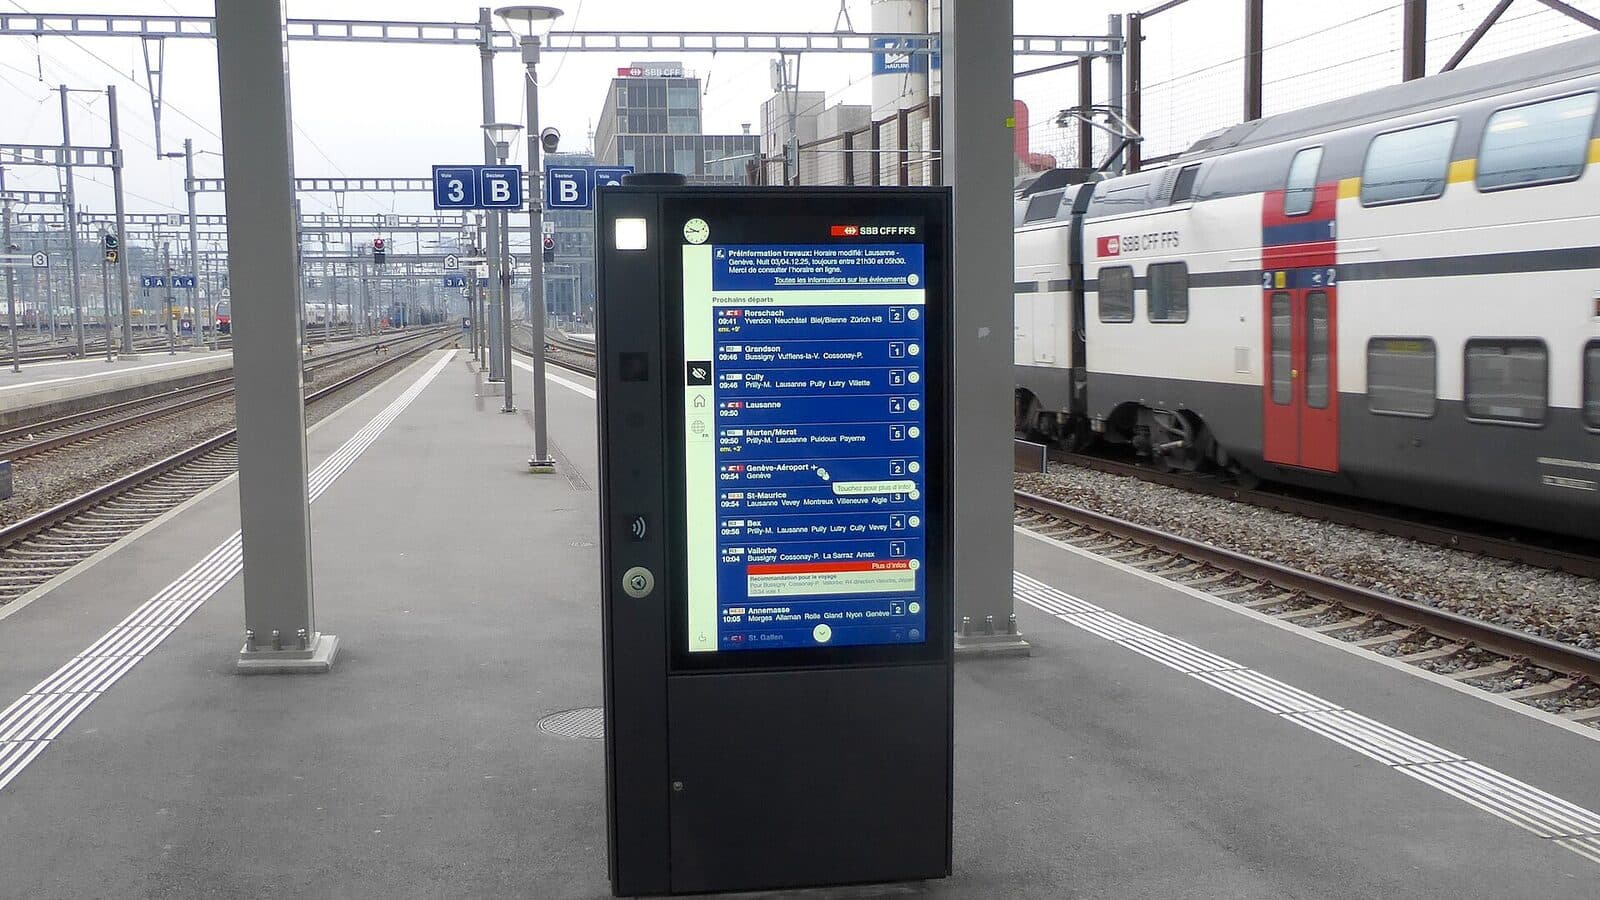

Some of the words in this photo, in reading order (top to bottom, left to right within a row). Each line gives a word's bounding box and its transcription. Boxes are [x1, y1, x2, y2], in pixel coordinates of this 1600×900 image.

[448, 180, 464, 202] 3
[492, 180, 510, 202] B
[560, 180, 578, 202] B
[860, 227, 878, 235] SBB
[1328, 220, 1336, 238] 1
[1122, 236, 1140, 252] SBB
[1142, 233, 1159, 250] CFF
[1162, 230, 1179, 248] FFS
[36, 254, 44, 265] 3
[448, 258, 454, 267] 3
[1263, 272, 1272, 288] 2
[1327, 269, 1336, 286] 2
